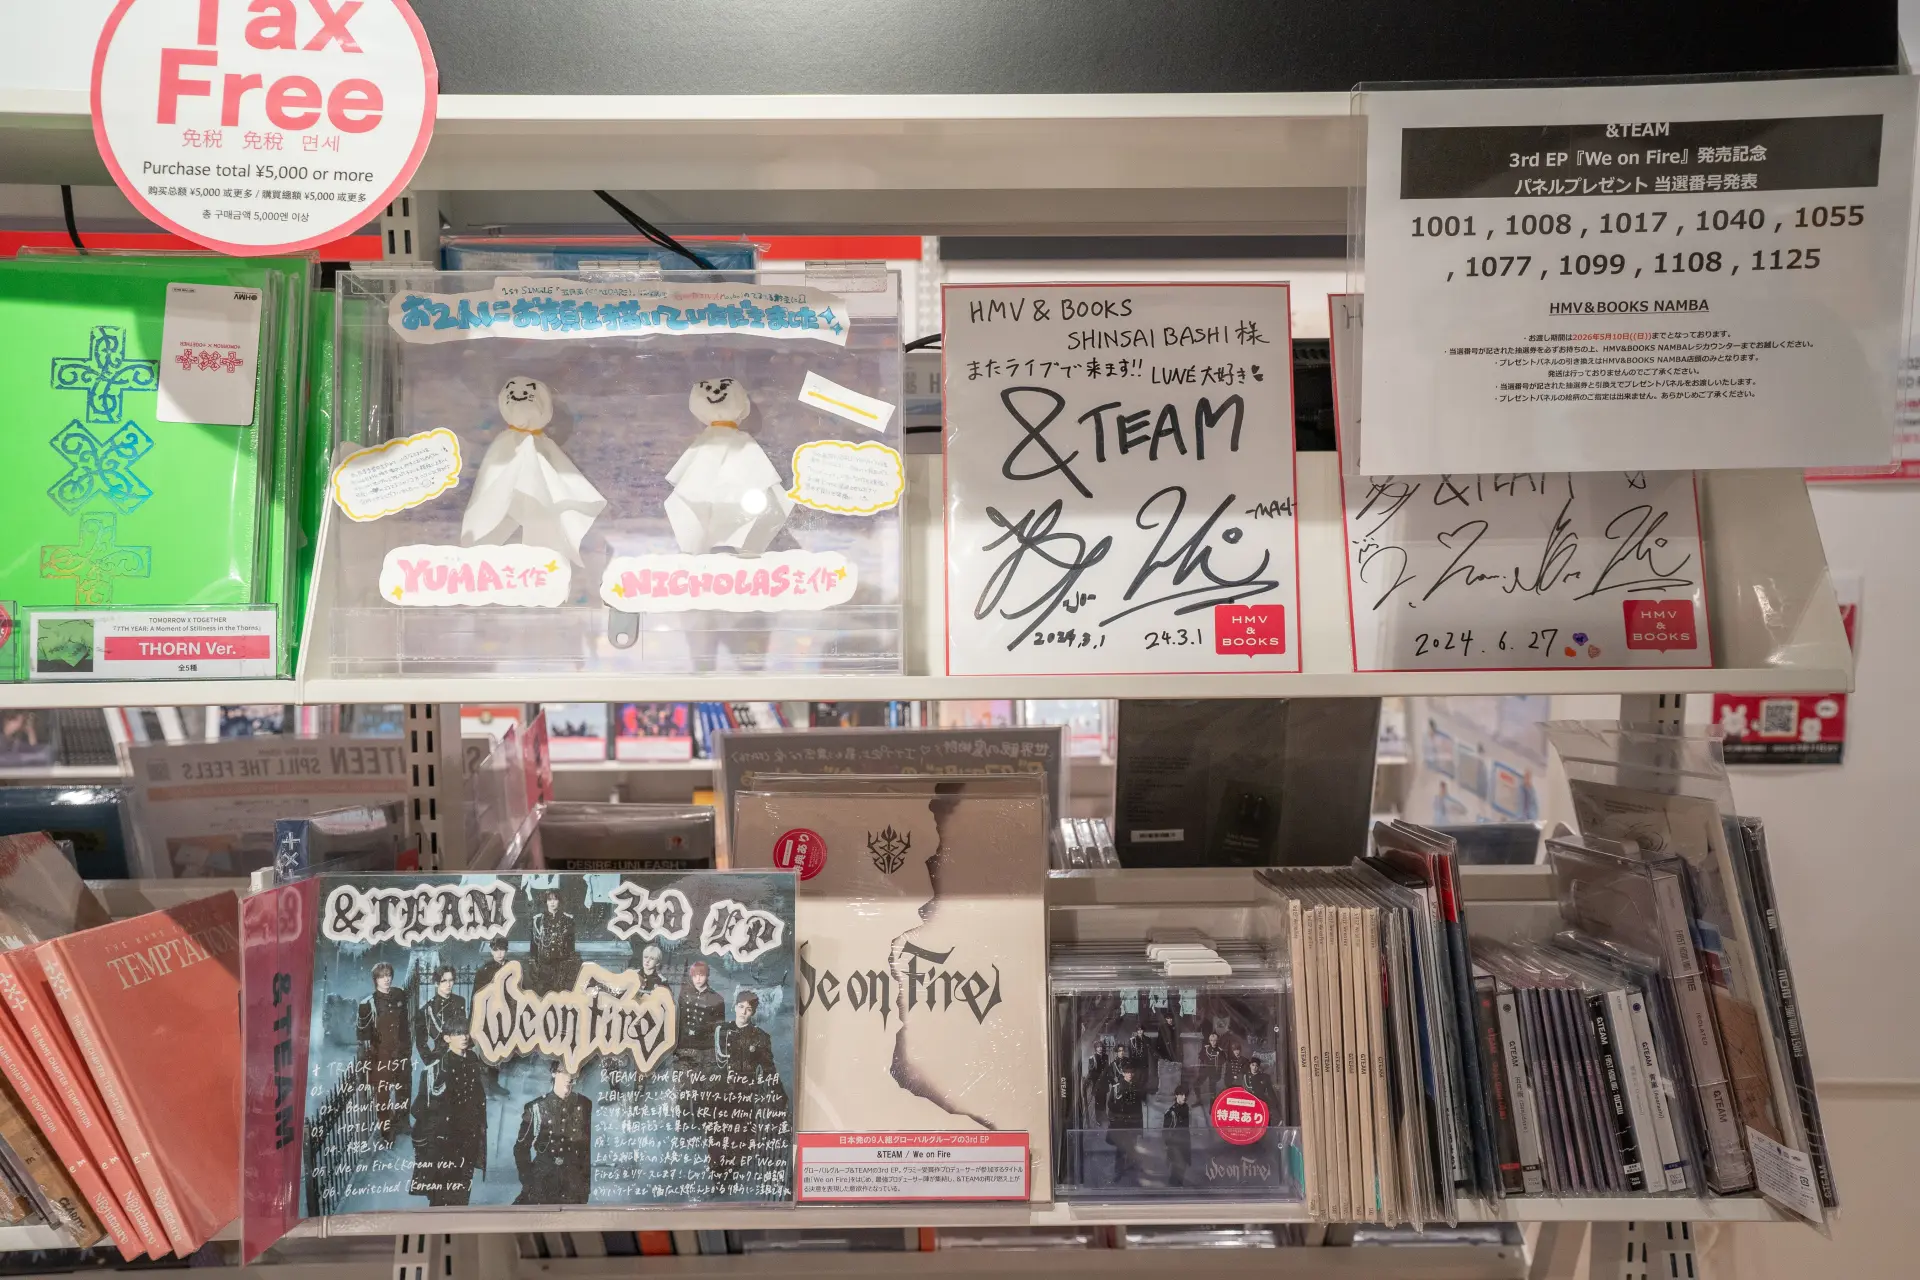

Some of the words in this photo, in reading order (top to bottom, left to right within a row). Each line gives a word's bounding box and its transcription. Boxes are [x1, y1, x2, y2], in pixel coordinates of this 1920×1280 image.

[157, 48, 384, 133] Free
[1606, 122, 1670, 138] &TEAM
[302, 135, 341, 153] 면세
[1509, 152, 1540, 168] 3rd
[1546, 153, 1568, 167] EP
[1617, 154, 1640, 165] on
[1697, 145, 1768, 163] 発売記念
[143, 160, 211, 177] Purchase
[216, 163, 251, 178] total
[255, 165, 308, 181] ¥5,000
[312, 169, 329, 181] or
[334, 169, 374, 182] more
[1514, 177, 1648, 195] パネルプレゼント
[1654, 173, 1758, 193] 当選番号発表
[190, 187, 221, 198] ¥5,000
[223, 188, 253, 199] 或更多
[304, 192, 335, 202] ¥5,000
[337, 192, 367, 203] 或更多
[202, 209, 211, 220] 총
[214, 210, 251, 221] 구매금액
[292, 211, 310, 223] 이상
[1411, 217, 1477, 238] 1001
[1505, 214, 1572, 236] 1008
[1599, 212, 1667, 235] 1017
[1695, 208, 1766, 232] 1040
[1794, 205, 1865, 228] 1055
[1465, 256, 1532, 277] 1077
[1559, 254, 1626, 276] 1099
[1654, 251, 1723, 274] 1108
[1751, 248, 1821, 271] 1125
[970, 298, 1026, 324] HMV
[1033, 298, 1051, 322] &
[1061, 298, 1133, 319] BOOKS
[1549, 300, 1649, 315] HMV&BOOKS
[1653, 299, 1709, 313] NAMBA
[1068, 328, 1154, 350] SHINSAI
[1163, 326, 1229, 347] BASHI
[1235, 320, 1271, 345] 様
[1232, 616, 1268, 624] HMV
[1641, 611, 1677, 619] HMV
[1656, 622, 1666, 630] &
[1144, 629, 1202, 650] 24.3.1
[1222, 637, 1279, 646] BOOKS
[1633, 633, 1690, 642] BOOKS
[139, 642, 201, 656] THORN
[206, 642, 236, 656] Ver.
[178, 664, 198, 672] 全5種
[332, 884, 511, 940] &TEAM
[611, 890, 692, 937] 3rd
[706, 903, 778, 958] EP
[106, 922, 240, 990] TEMPTATION
[899, 940, 1003, 1025] Fire
[1596, 1016, 1609, 1045] &TEAM
[272, 971, 295, 1151] &TEAM
[1508, 1040, 1519, 1067] &TEAM
[1642, 1041, 1653, 1066] &TEAM
[326, 1060, 372, 1073] TRACK
[377, 1058, 408, 1071] LIST
[30, 1024, 41, 1038] THE
[36, 1036, 51, 1059] NAME
[49, 1055, 69, 1092] CHAPTER
[66, 1088, 93, 1129] TEMPTATION
[709, 1074, 722, 1083] on
[335, 1082, 355, 1094] We
[358, 1083, 374, 1092] on
[377, 1079, 403, 1093] Fire
[9, 1062, 32, 1095] CHAPTER
[30, 1095, 57, 1133] TEMPTATION
[345, 1098, 410, 1114] Bewitched
[1713, 1090, 1728, 1123] &TEAM
[1216, 1108, 1264, 1124] 特典あり
[337, 1119, 391, 1135] HOTLINE
[980, 1135, 990, 1144] EP
[877, 1150, 902, 1158] &TEAM
[913, 1150, 924, 1158] We
[937, 1150, 951, 1158] Fire
[335, 1162, 351, 1176] We
[356, 1164, 368, 1173] on
[345, 1182, 400, 1197] Bewitched
[93, 1191, 129, 1245] Nightmare
[124, 1190, 156, 1245] Nightmare
[152, 1187, 182, 1242] Nightmare
